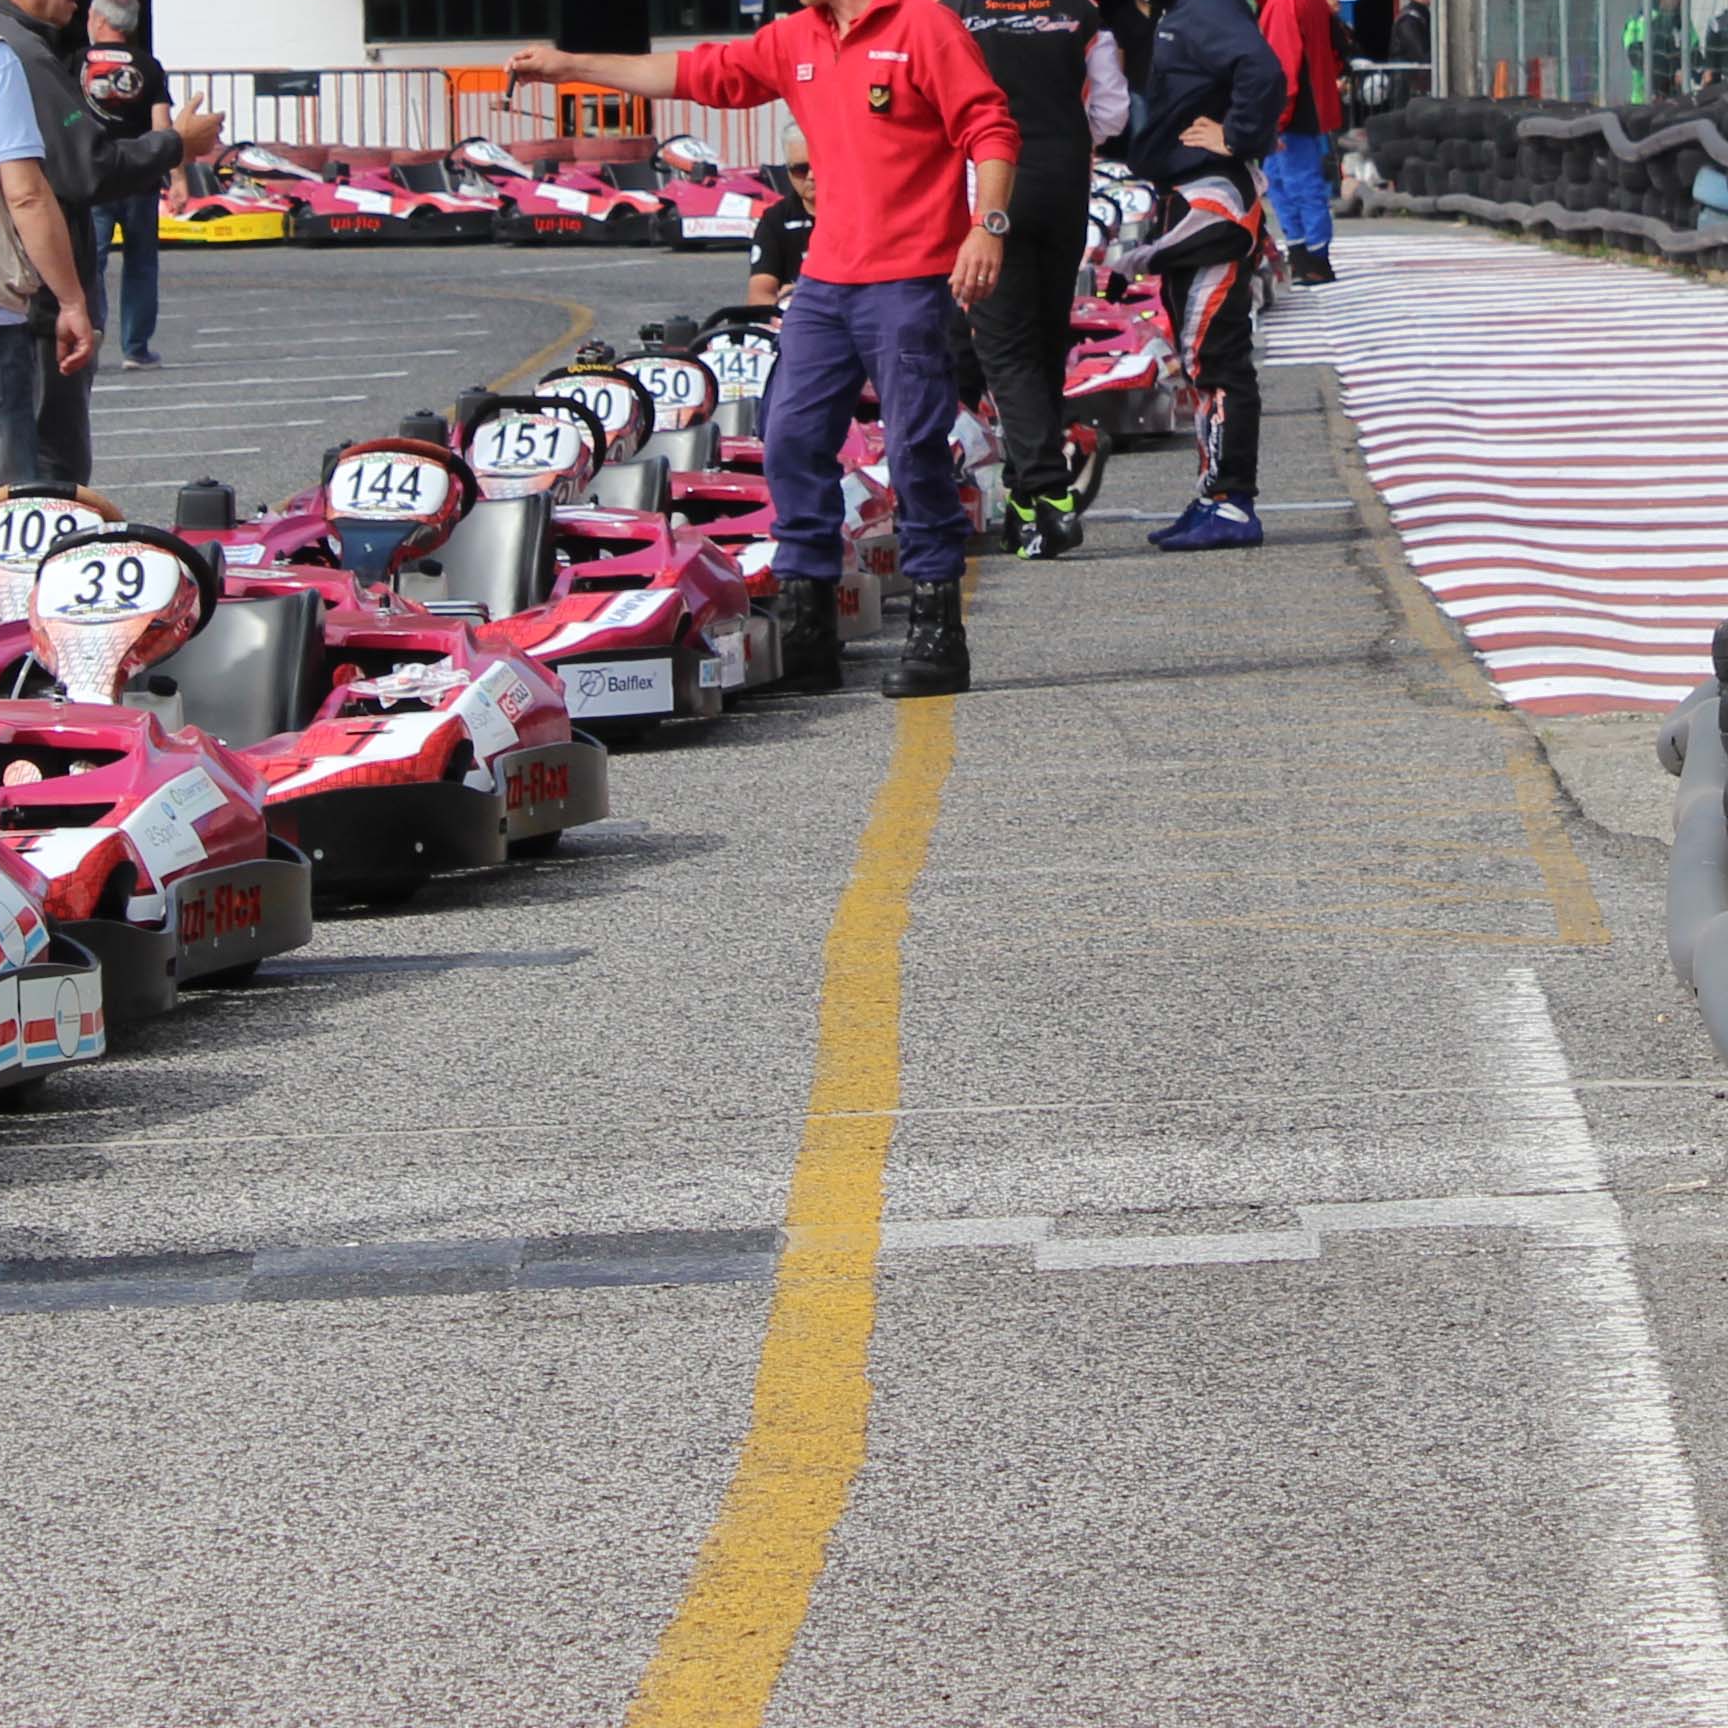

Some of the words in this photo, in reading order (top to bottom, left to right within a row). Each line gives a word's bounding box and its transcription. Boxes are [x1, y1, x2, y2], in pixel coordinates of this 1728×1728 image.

[713, 352, 760, 379] 141
[491, 422, 561, 460] 151
[348, 462, 422, 502] 144
[75, 556, 145, 605] 39
[608, 675, 654, 693] Balflex
